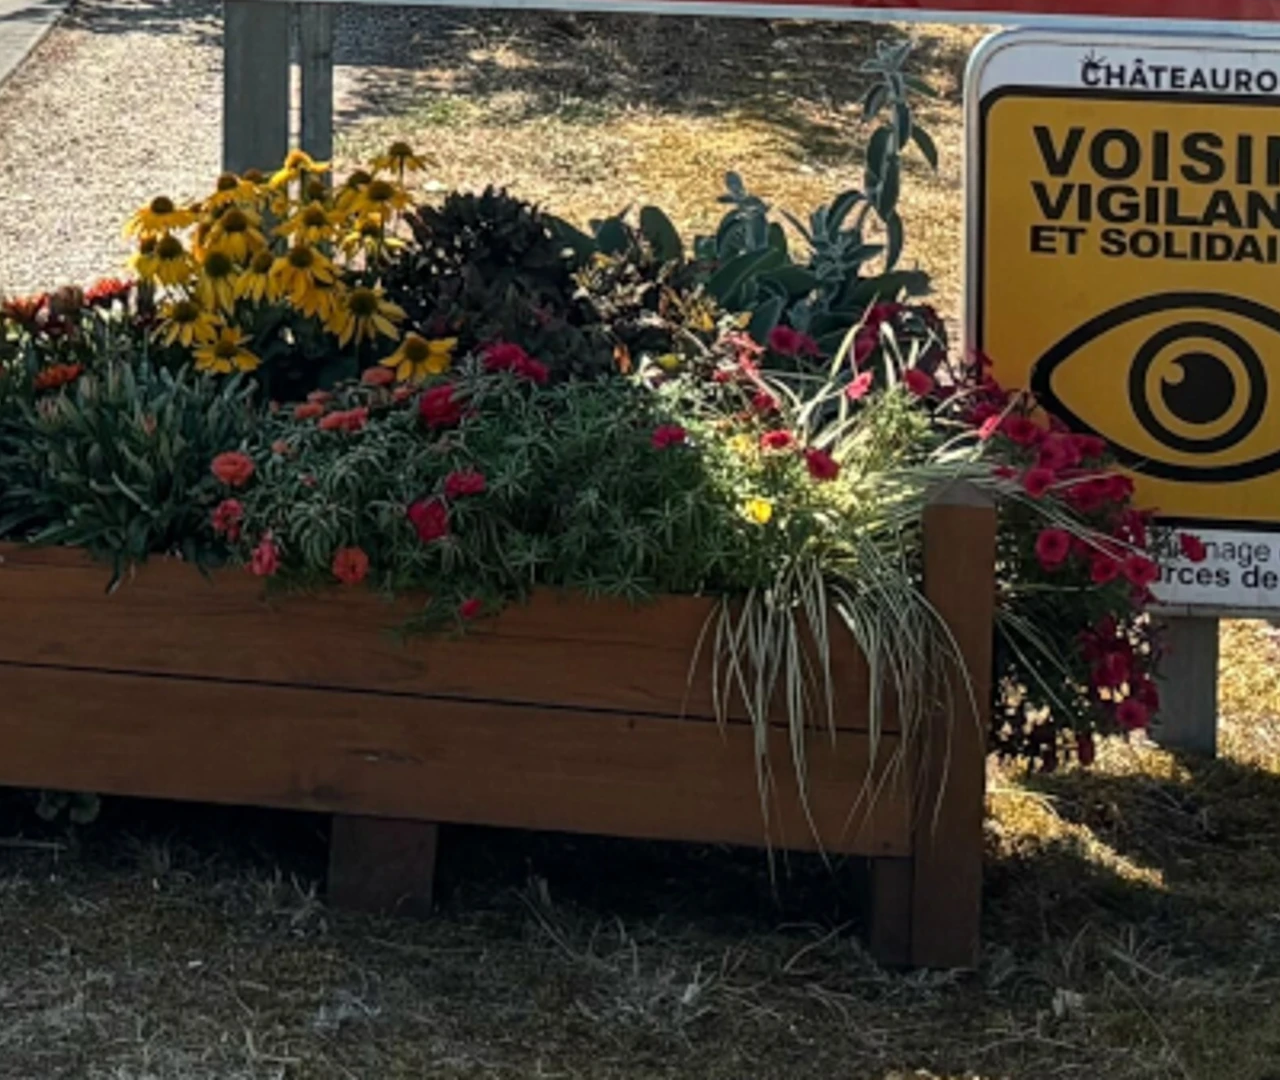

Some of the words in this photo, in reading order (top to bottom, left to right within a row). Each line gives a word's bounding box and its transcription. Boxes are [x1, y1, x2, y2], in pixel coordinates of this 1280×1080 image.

[1030, 224, 1087, 255] ET
[1157, 566, 1231, 588] rces
[1241, 565, 1279, 590] de
